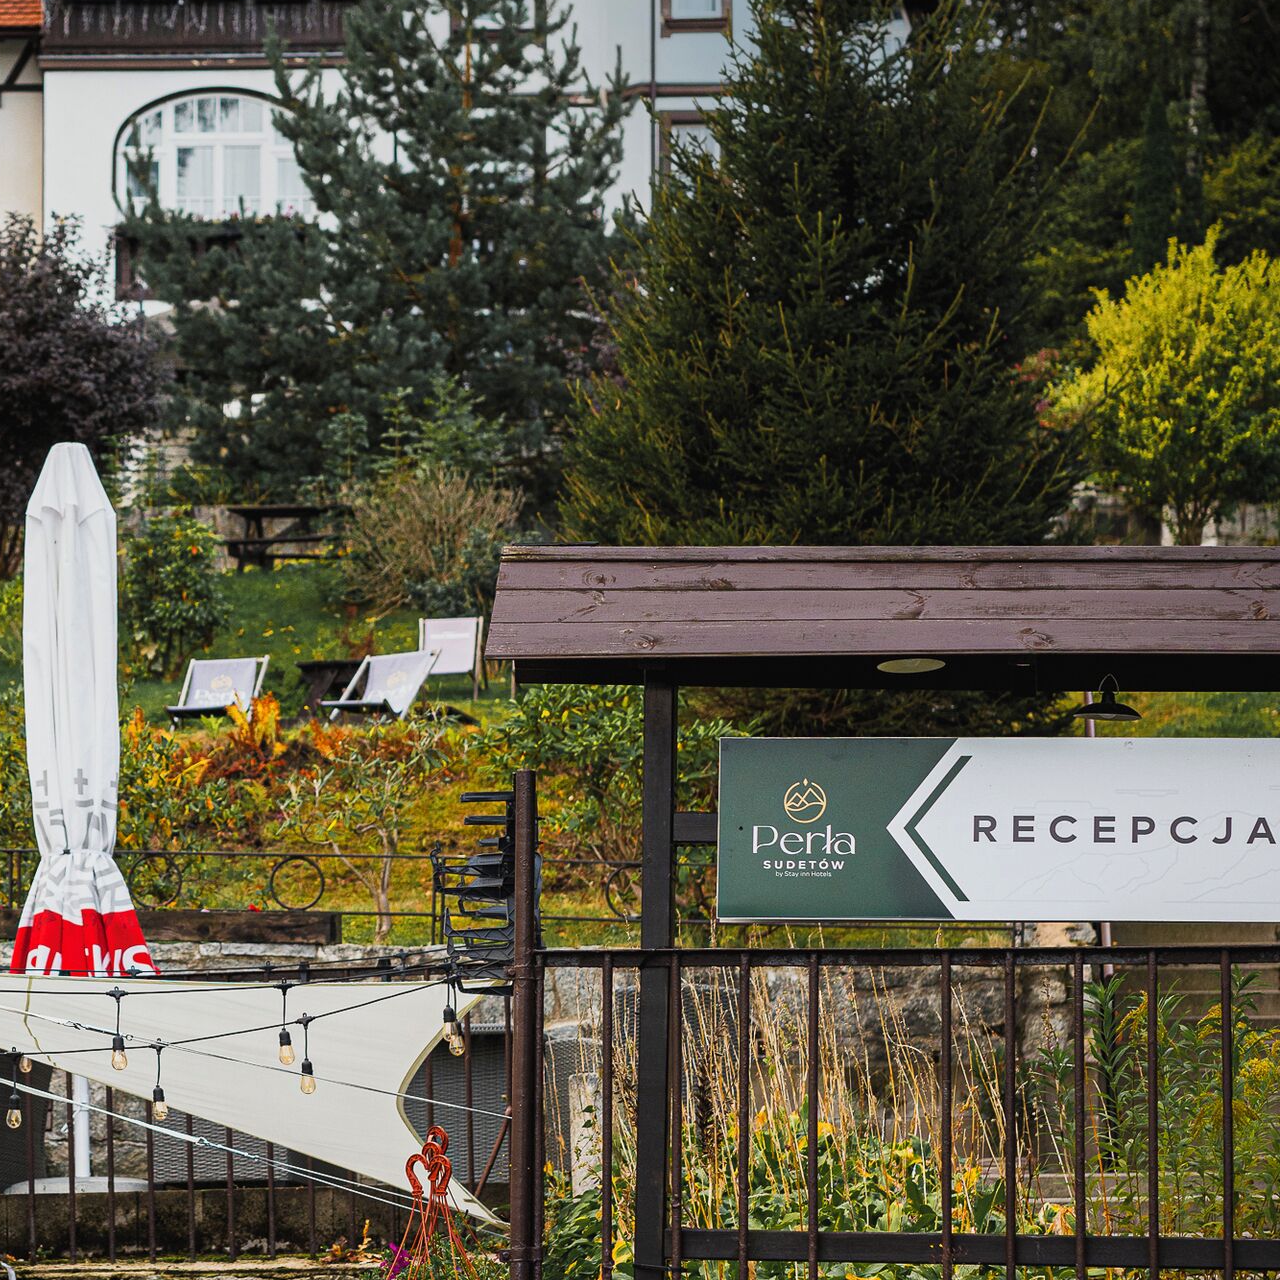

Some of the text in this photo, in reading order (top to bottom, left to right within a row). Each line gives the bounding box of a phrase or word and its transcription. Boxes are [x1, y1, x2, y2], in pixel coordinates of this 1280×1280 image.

[752, 824, 856, 855] Perła
[972, 815, 1277, 844] RECEPCJA
[763, 858, 845, 870] SUDETÓW
